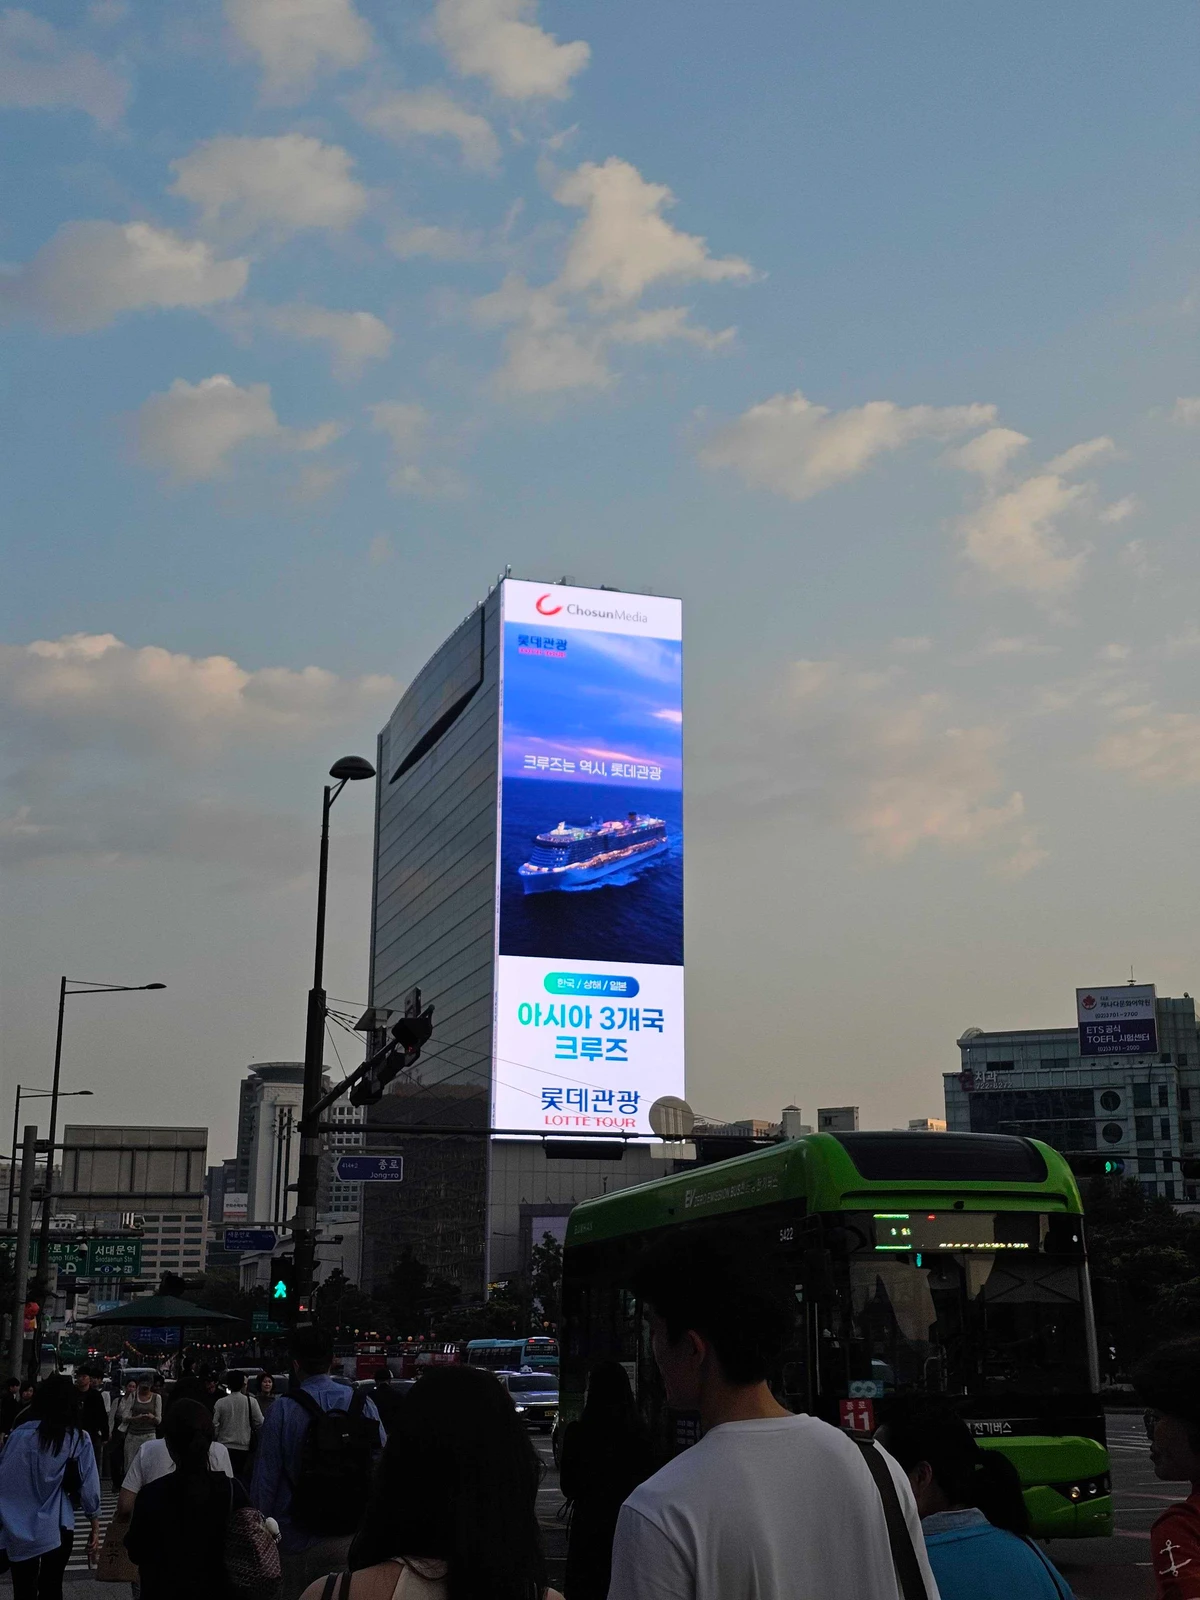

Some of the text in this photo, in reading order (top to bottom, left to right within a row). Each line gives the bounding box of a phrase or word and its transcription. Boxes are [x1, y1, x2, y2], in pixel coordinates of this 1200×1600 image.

[567, 604, 648, 623] ChosunMedia
[523, 755, 662, 781] 크루즈는 역시, 롯데관광
[557, 978, 575, 989] 한국
[583, 980, 602, 990] 상해
[609, 981, 627, 992] 일본
[518, 1002, 664, 1033] 아시아 3개국
[1086, 1024, 1121, 1034] ETS 공식
[1086, 1033, 1150, 1043] TOEFL 시험센터
[555, 1035, 628, 1062] 크루즈
[541, 1087, 641, 1115] 롯데관광
[545, 1115, 636, 1128] LOTTE TOUR
[378, 1159, 399, 1171] 종로
[685, 1189, 696, 1208] EV
[779, 1227, 794, 1241] 5422
[95, 1245, 136, 1256] 서대문역
[845, 1400, 867, 1411] 종로
[843, 1411, 870, 1431] 11
[973, 1422, 1012, 1436] 전기버스
